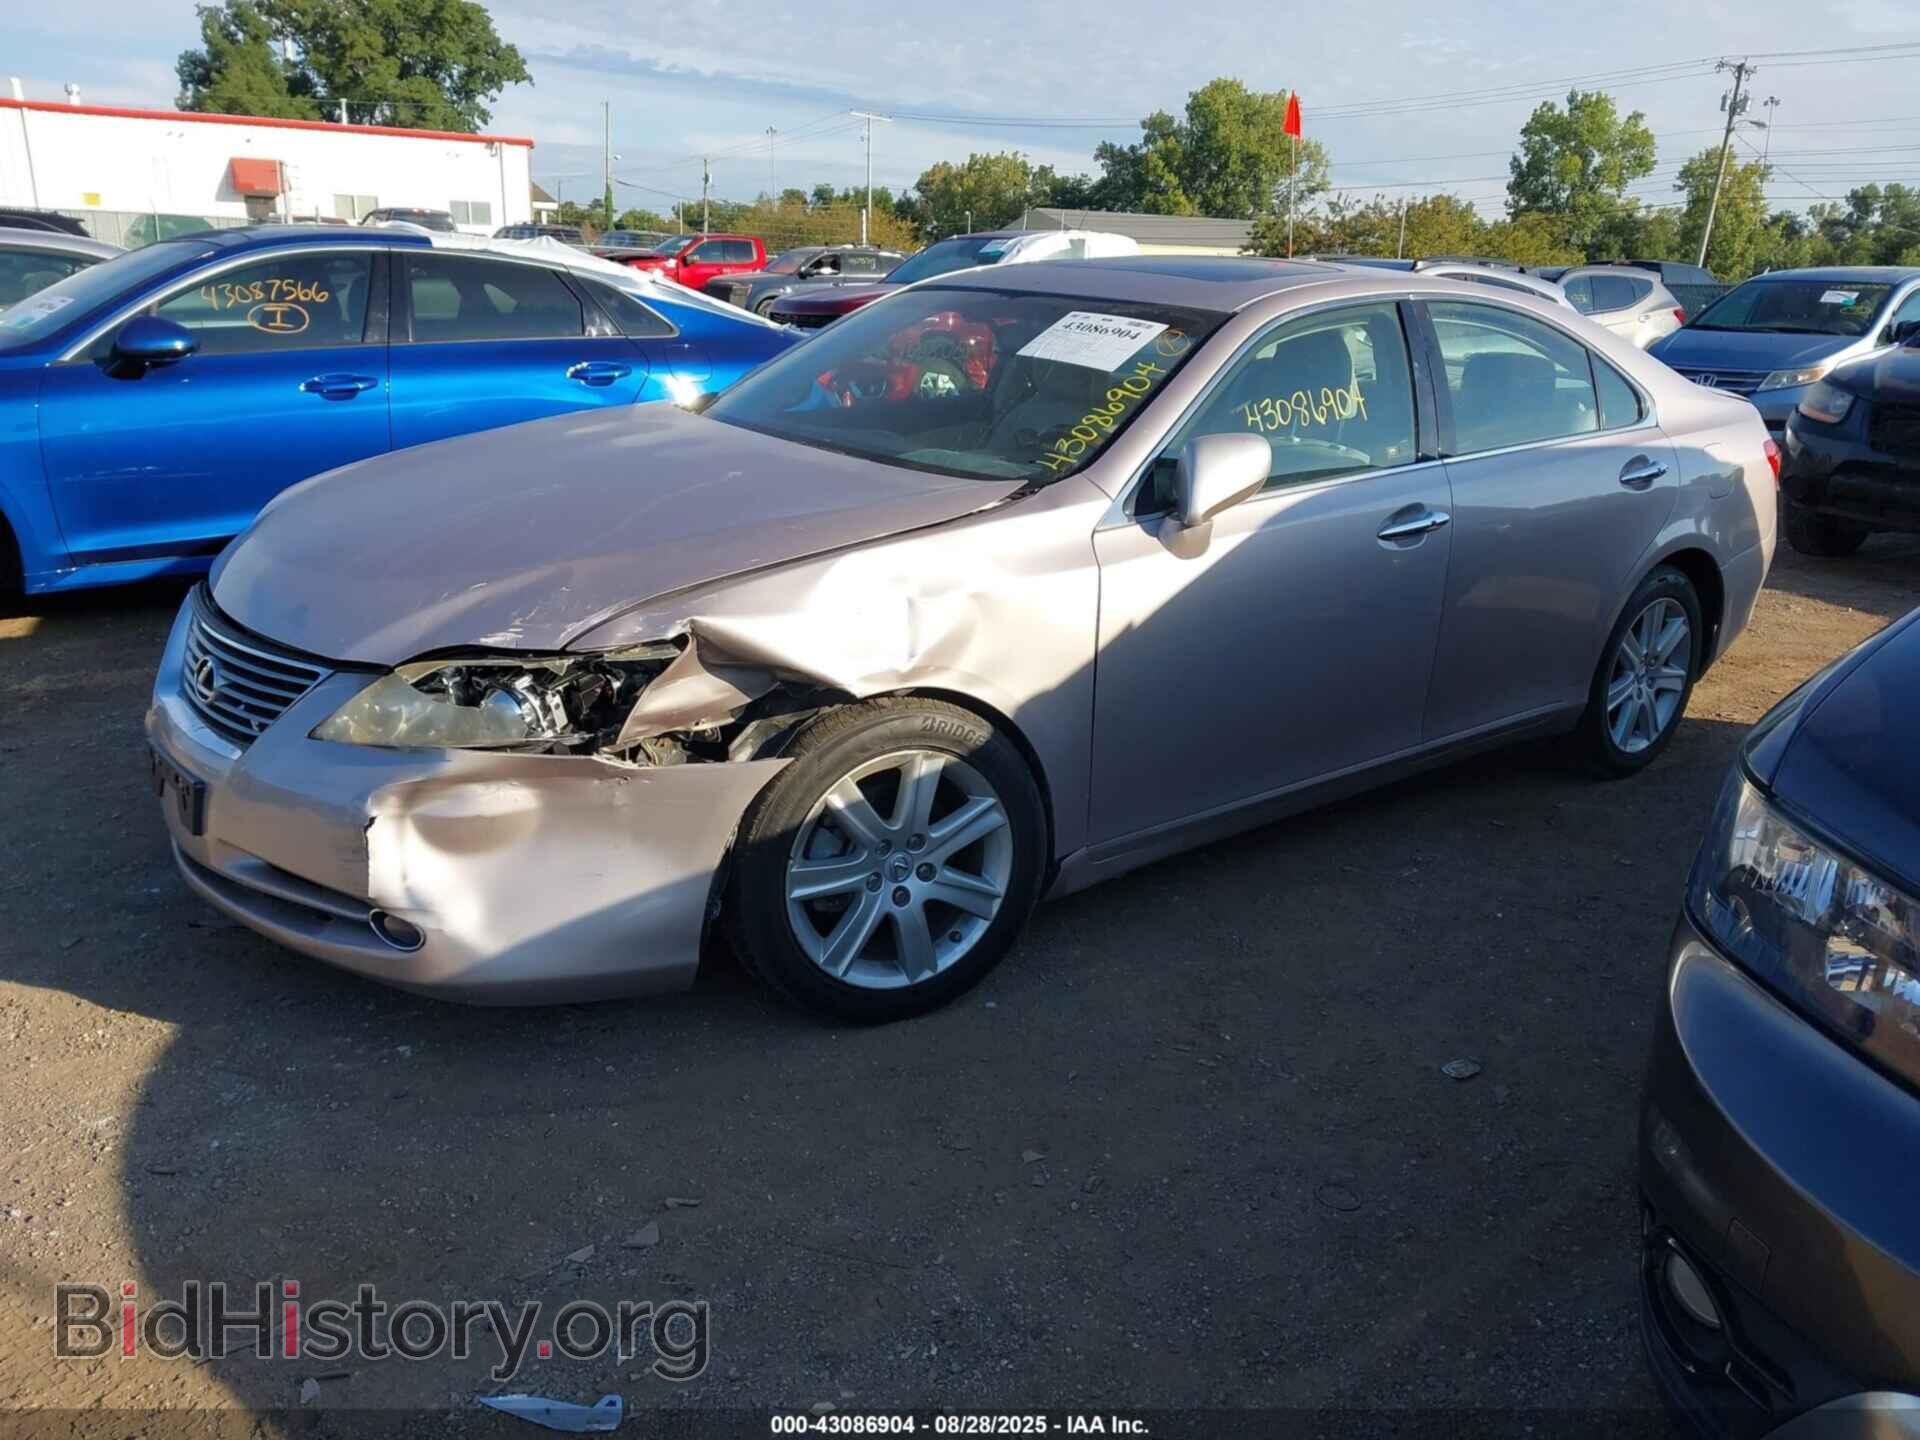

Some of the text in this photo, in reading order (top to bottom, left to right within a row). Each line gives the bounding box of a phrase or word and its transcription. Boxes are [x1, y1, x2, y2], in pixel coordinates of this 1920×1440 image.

[201, 279, 329, 311] 43087566
[1063, 321, 1141, 340] 43086904
[1035, 362, 1167, 470] 43086904
[1243, 387, 1368, 433] 43086904
